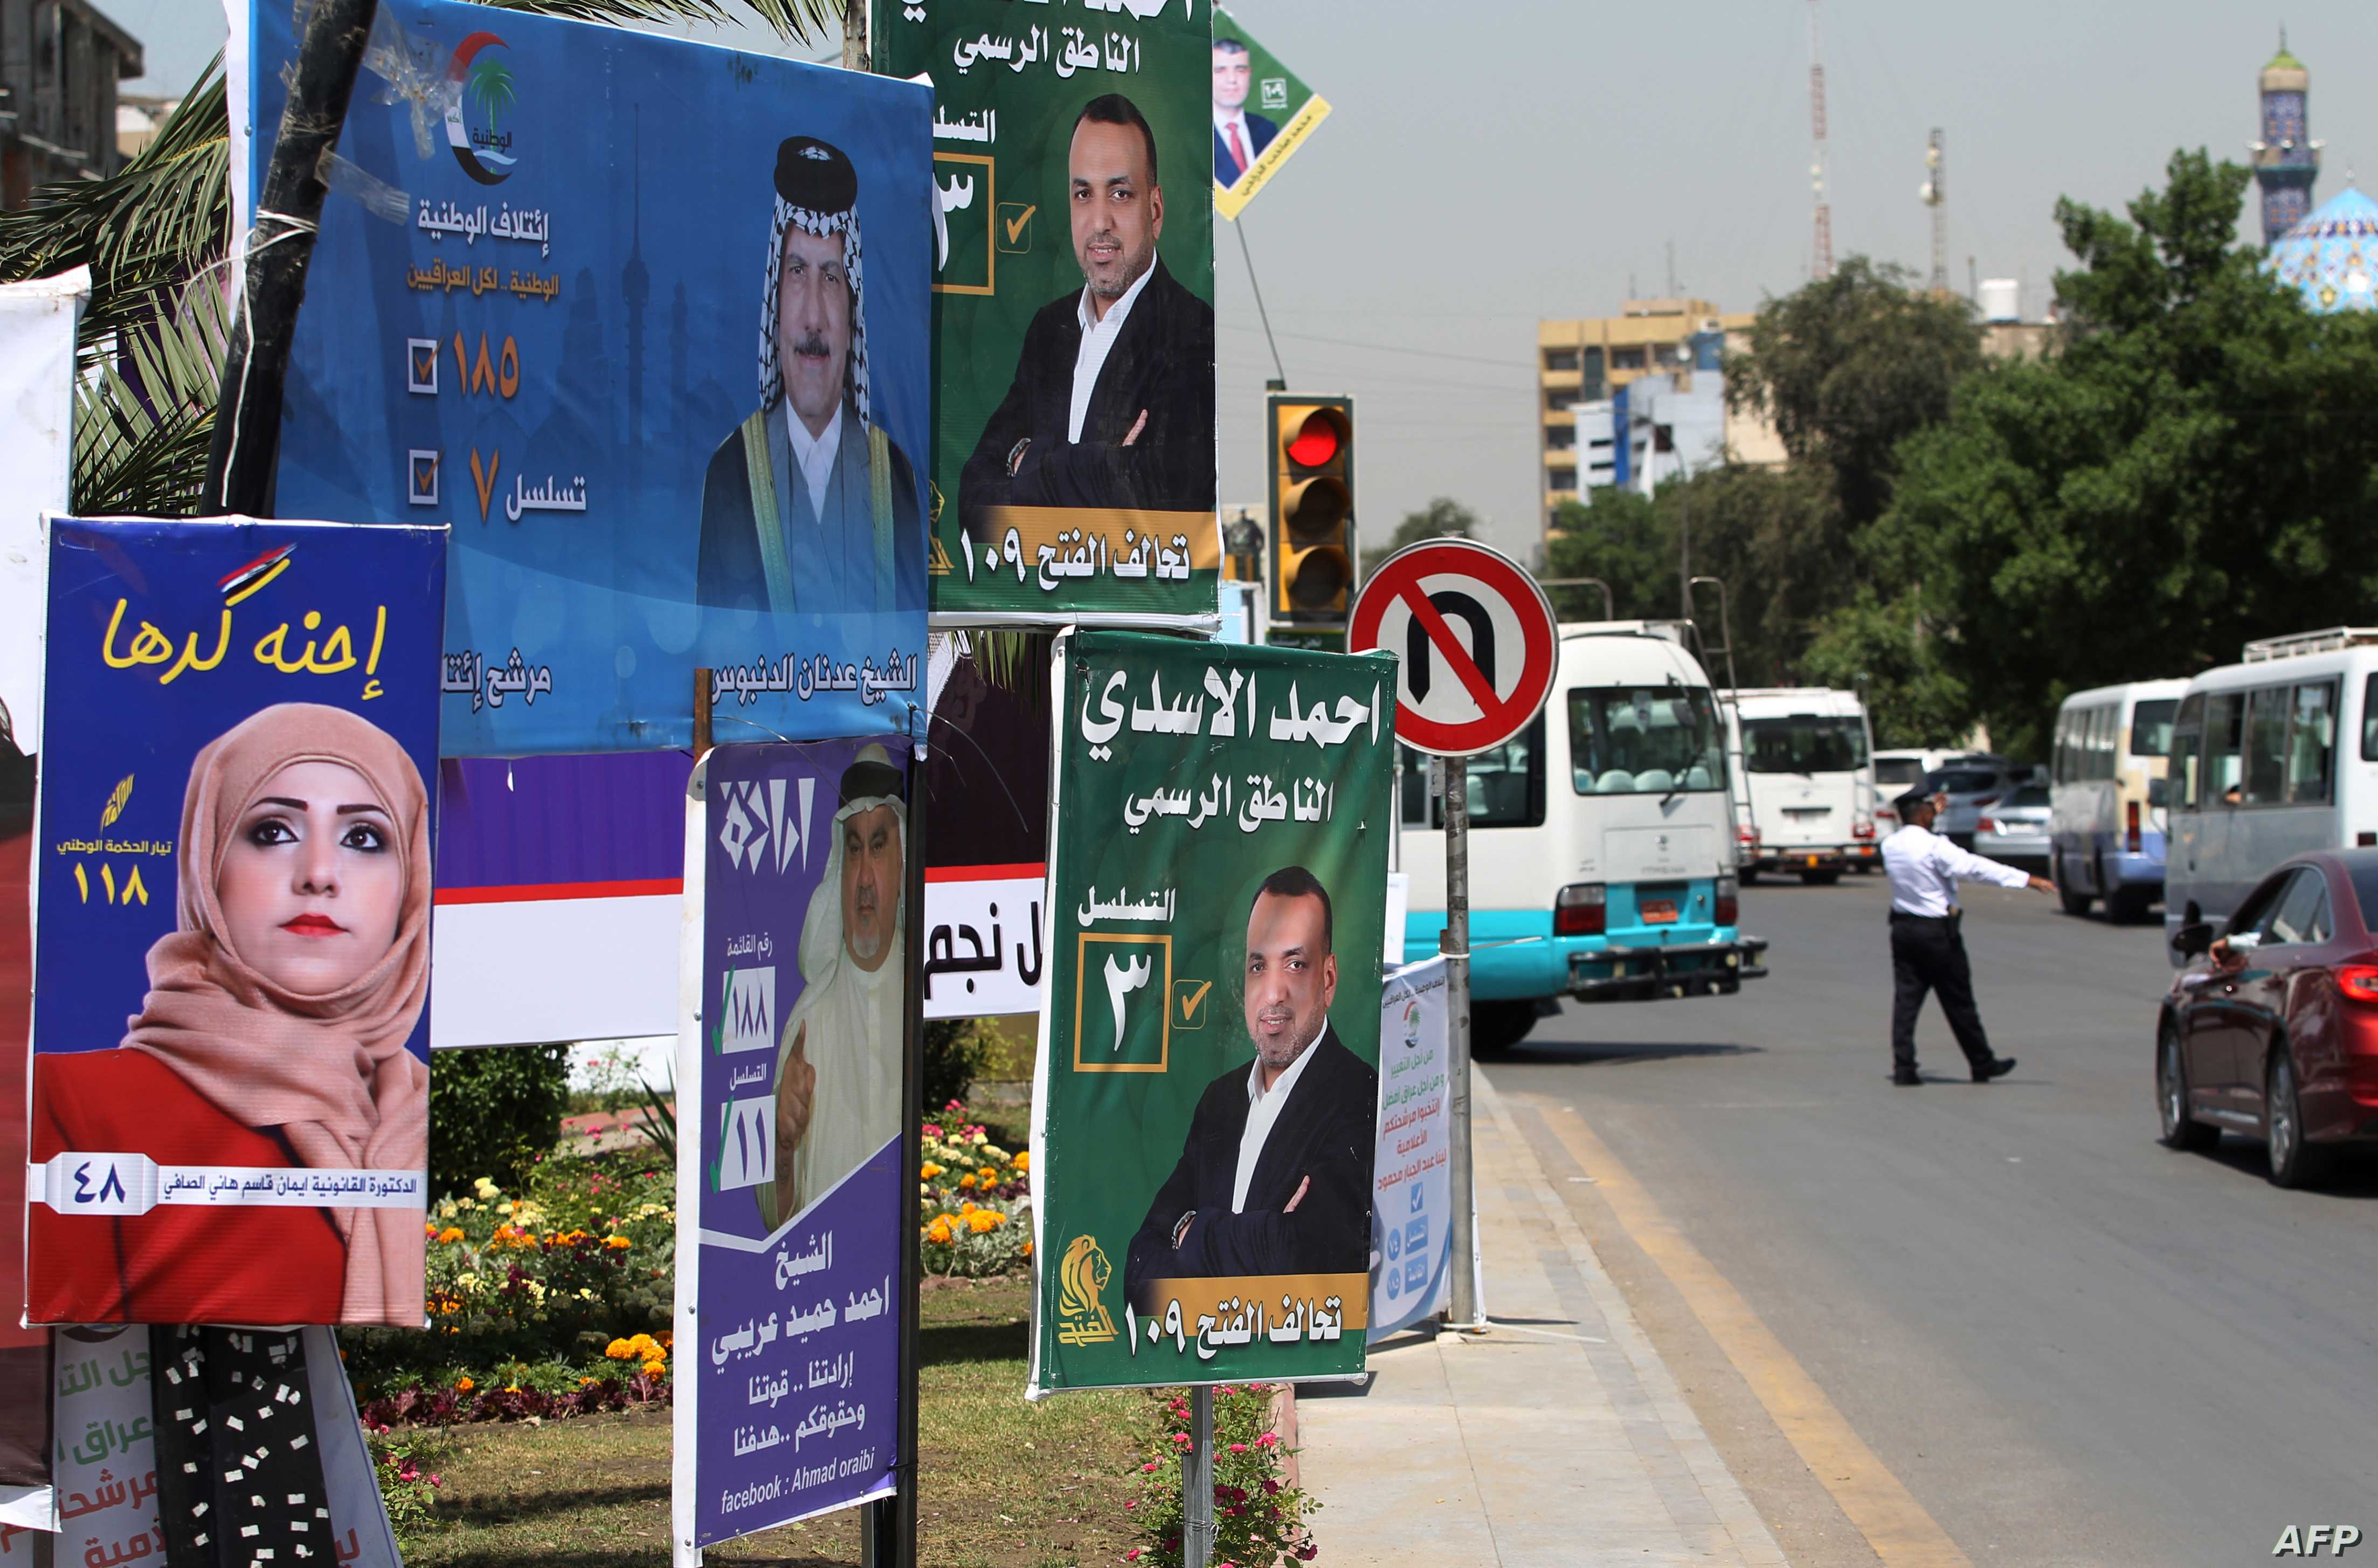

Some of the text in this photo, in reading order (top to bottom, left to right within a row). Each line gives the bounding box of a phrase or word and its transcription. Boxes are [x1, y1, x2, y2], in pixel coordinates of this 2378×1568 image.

[954, 23, 1140, 78] الناطق الرسمي
[472, 126, 512, 153] الوطنية
[933, 105, 996, 144] التسل
[418, 198, 487, 245] الوطنية
[407, 257, 471, 293] العراقيين
[472, 267, 498, 296] لكل
[510, 270, 559, 303] الوطنية
[453, 329, 520, 398] ١٨٥
[469, 447, 587, 522] تسلسل ٧
[960, 526, 1026, 584] ١٠٩
[1036, 526, 1107, 591] الفتح
[1112, 528, 1191, 581] تحالف
[486, 647, 552, 708] مرشح
[713, 648, 917, 707] الشيخ عدنان الدنبوس
[1081, 666, 1380, 762] احمد الاسدي
[1123, 772, 1334, 835] الناطق الرسمي
[56, 838, 173, 856] تيار الحكمة الوطني
[73, 862, 149, 906] ١١٨
[1077, 885, 1177, 927] التسلسل
[727, 931, 773, 962] رقم القائمة
[924, 902, 1003, 1000] نجم
[733, 984, 768, 1040] ١٨٨
[1103, 953, 1152, 1052] ٣
[729, 1062, 767, 1092] التسلسل
[1423, 1049, 1434, 1065] من
[1401, 1085, 1416, 1105] عراق
[736, 1106, 768, 1182] ١١
[1382, 1107, 1416, 1141] مرشحتكم
[74, 1161, 126, 1204] ٤٨
[164, 1172, 418, 1201] الدكتورة القانونية ايمان قاسم هاني الصافي
[1377, 1169, 1403, 1192] محمود
[1403, 1159, 1421, 1183] الجبار
[1422, 1156, 1435, 1173] عبد
[775, 1229, 833, 1290] الشيخ
[711, 1274, 890, 1376] احمد حميد عريبي
[1124, 1293, 1343, 1360] تحالف الفتح ١٠٩
[749, 1369, 789, 1409] قوتنا
[808, 1350, 854, 1390] إرادتنا
[795, 1399, 866, 1454] وحقوقكم
[721, 1474, 782, 1515] facebook
[791, 1457, 838, 1494] Ahmad
[839, 1446, 876, 1476] oraibi
